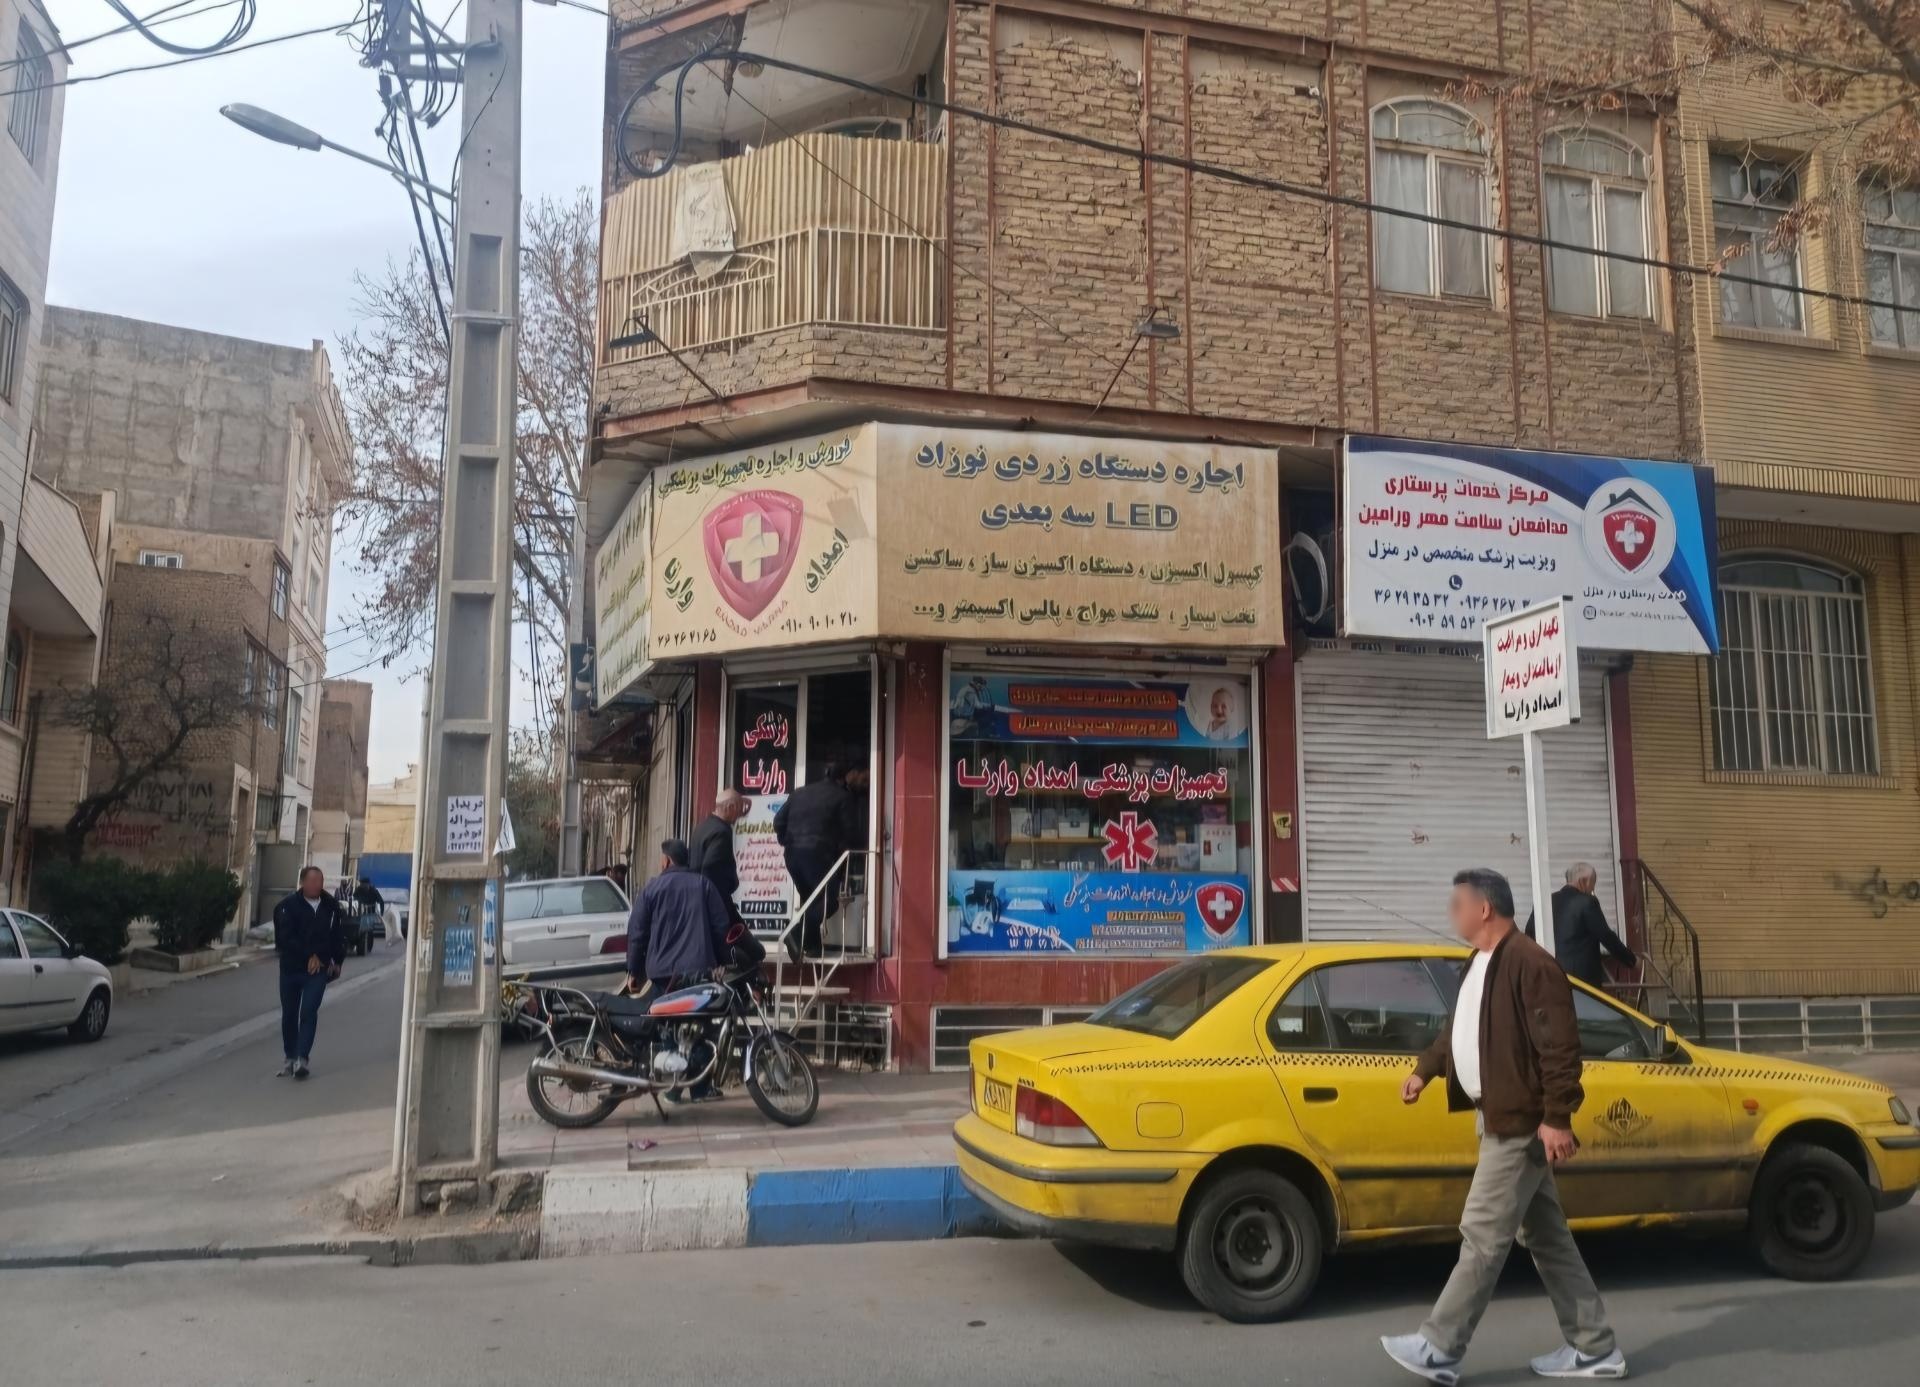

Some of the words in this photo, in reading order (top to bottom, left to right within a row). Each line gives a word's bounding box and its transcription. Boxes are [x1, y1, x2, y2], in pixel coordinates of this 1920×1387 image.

[757, 446, 793, 478] اجاره
[795, 452, 804, 471] و
[807, 435, 852, 468] فروش
[915, 440, 988, 478] نوزاد
[702, 456, 754, 487] تجهیزات
[994, 453, 1073, 484] زردی
[1077, 453, 1168, 482] دستگاه
[1173, 462, 1245, 493] اجاره
[658, 469, 700, 497] پزشکی
[1385, 475, 1447, 503] پرستاری
[1454, 479, 1501, 499] خدمات
[1506, 483, 1549, 505] مرکز
[980, 502, 1054, 532] بعدی
[1059, 504, 1096, 526] سه
[1106, 502, 1180, 531] LED
[1359, 504, 1410, 528] ورامین
[1417, 511, 1449, 529] مهر
[1455, 511, 1502, 530] سلامت
[1508, 516, 1568, 536] مدافعان
[804, 527, 850, 593] امداد
[904, 549, 964, 572] ساکشن
[1369, 539, 1399, 560] منزل
[1404, 544, 1419, 561] در
[1423, 546, 1474, 563] متخصص
[1479, 548, 1514, 570] پزشک
[1518, 553, 1556, 571] ویزیت
[979, 552, 1009, 577] ساز
[1013, 555, 1075, 579] اکسیژن
[1078, 555, 1134, 577] دستگاه
[1150, 561, 1208, 585] اکسیژن
[1213, 561, 1262, 591] کپسول
[663, 557, 695, 612] وارنا
[1584, 586, 1603, 597] منزل
[1608, 590, 1616, 599] در
[1620, 589, 1655, 602] پرستاری
[949, 598, 1014, 623] اکسیمتر
[1018, 599, 1063, 627] پالس
[1180, 605, 1217, 631] بیمار
[1221, 607, 1257, 627] تخت
[1497, 629, 1522, 653] مراقبت
[1523, 633, 1528, 650] و
[1529, 616, 1559, 648] نگهداری
[1555, 652, 1561, 679] از
[1505, 698, 1530, 722] وارنا
[1532, 689, 1561, 713] امداد
[743, 710, 788, 749] پزشکی
[743, 759, 786, 795] وارنا
[958, 758, 1018, 796] وارنا
[1023, 761, 1078, 789] امداد
[1083, 763, 1149, 803] پزشکی
[1150, 765, 1227, 800] تجهیزات
